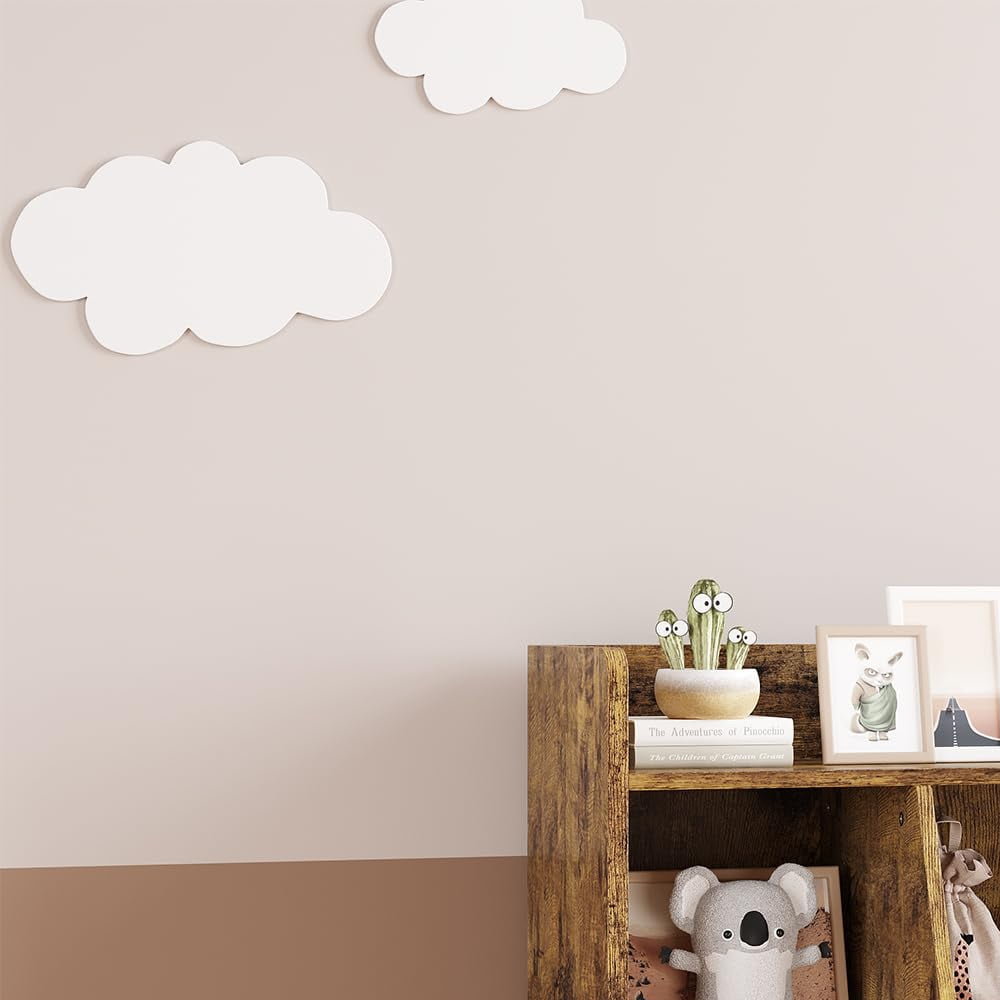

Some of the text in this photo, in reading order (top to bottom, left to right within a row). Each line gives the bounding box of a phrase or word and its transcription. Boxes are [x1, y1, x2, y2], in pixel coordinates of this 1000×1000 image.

[649, 726, 785, 737] The Adventures of Pinocchio
[709, 754, 720, 762] of
[721, 753, 756, 761] Captain
